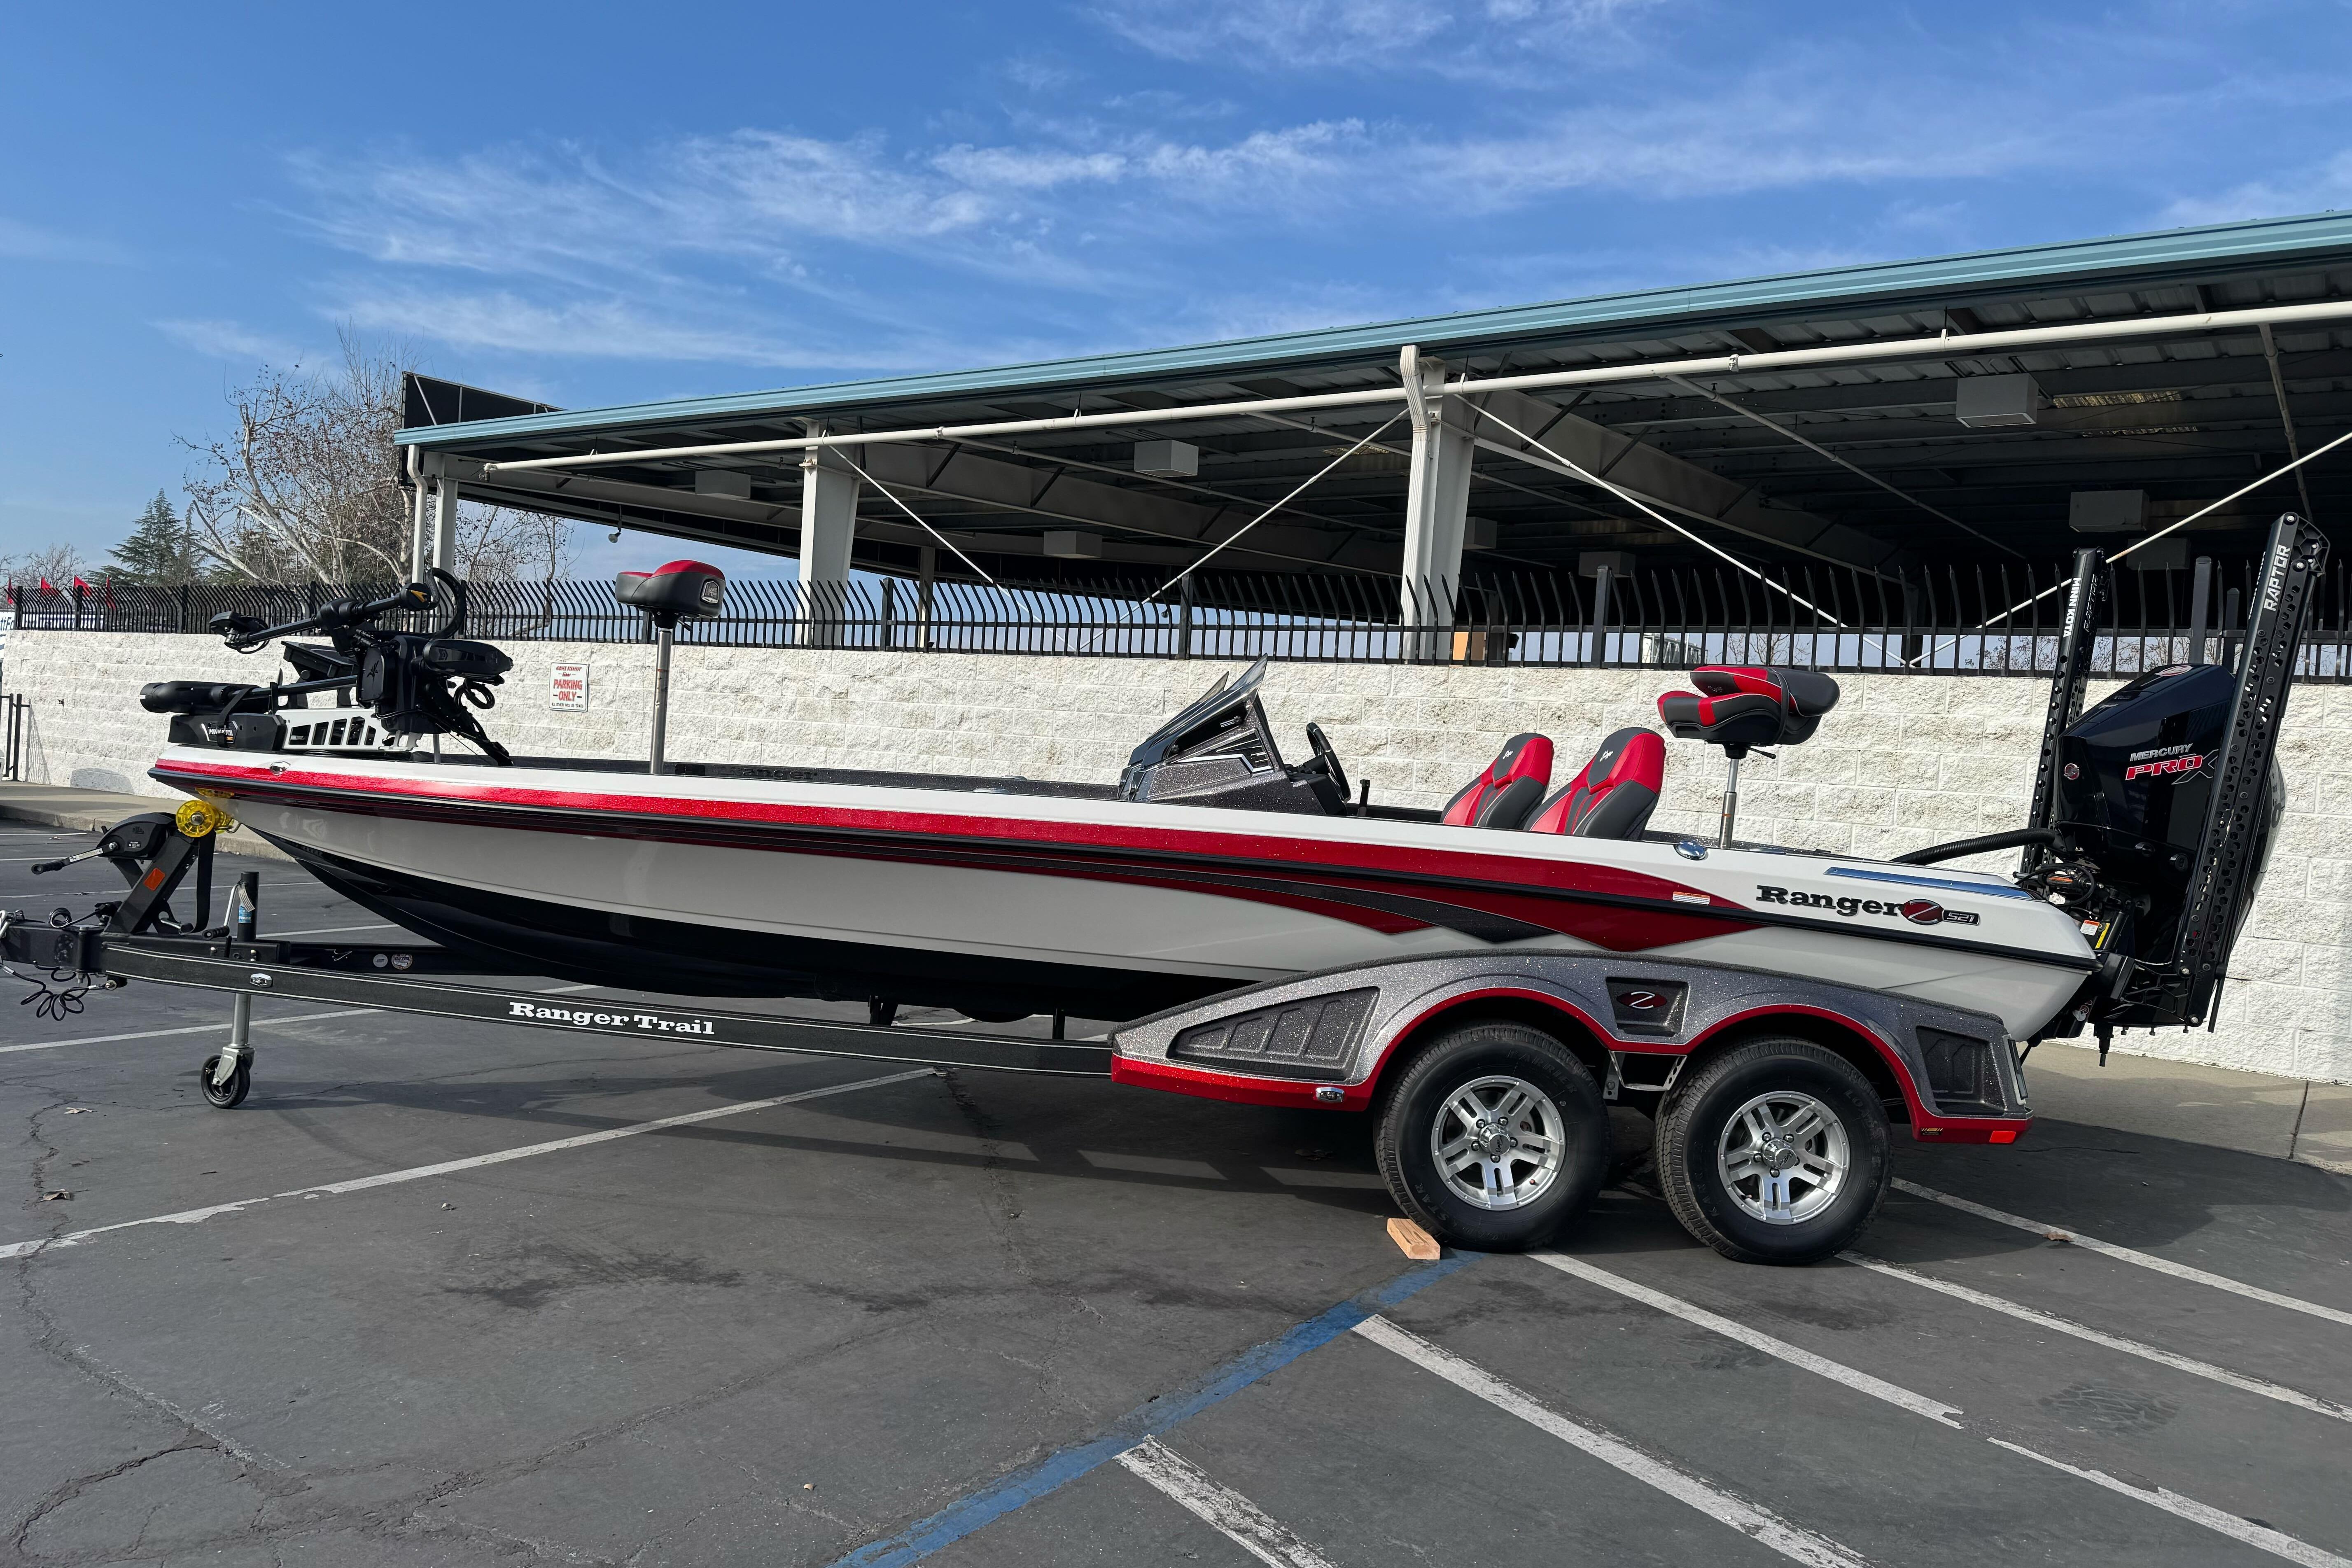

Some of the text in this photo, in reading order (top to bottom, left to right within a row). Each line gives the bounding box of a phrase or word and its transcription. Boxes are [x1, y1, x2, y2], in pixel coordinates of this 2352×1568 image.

[2263, 544, 2291, 611] RAPTOR
[2063, 577, 2081, 638] MINN KOTA
[553, 679, 583, 690] PARKING
[558, 691, 576, 702] ONLY
[2130, 743, 2193, 761] MERCURY
[2125, 755, 2203, 781] PRO
[1756, 884, 1906, 917] Ranger
[1947, 912, 1975, 922] 521
[509, 1001, 715, 1035] Ranger Trail
